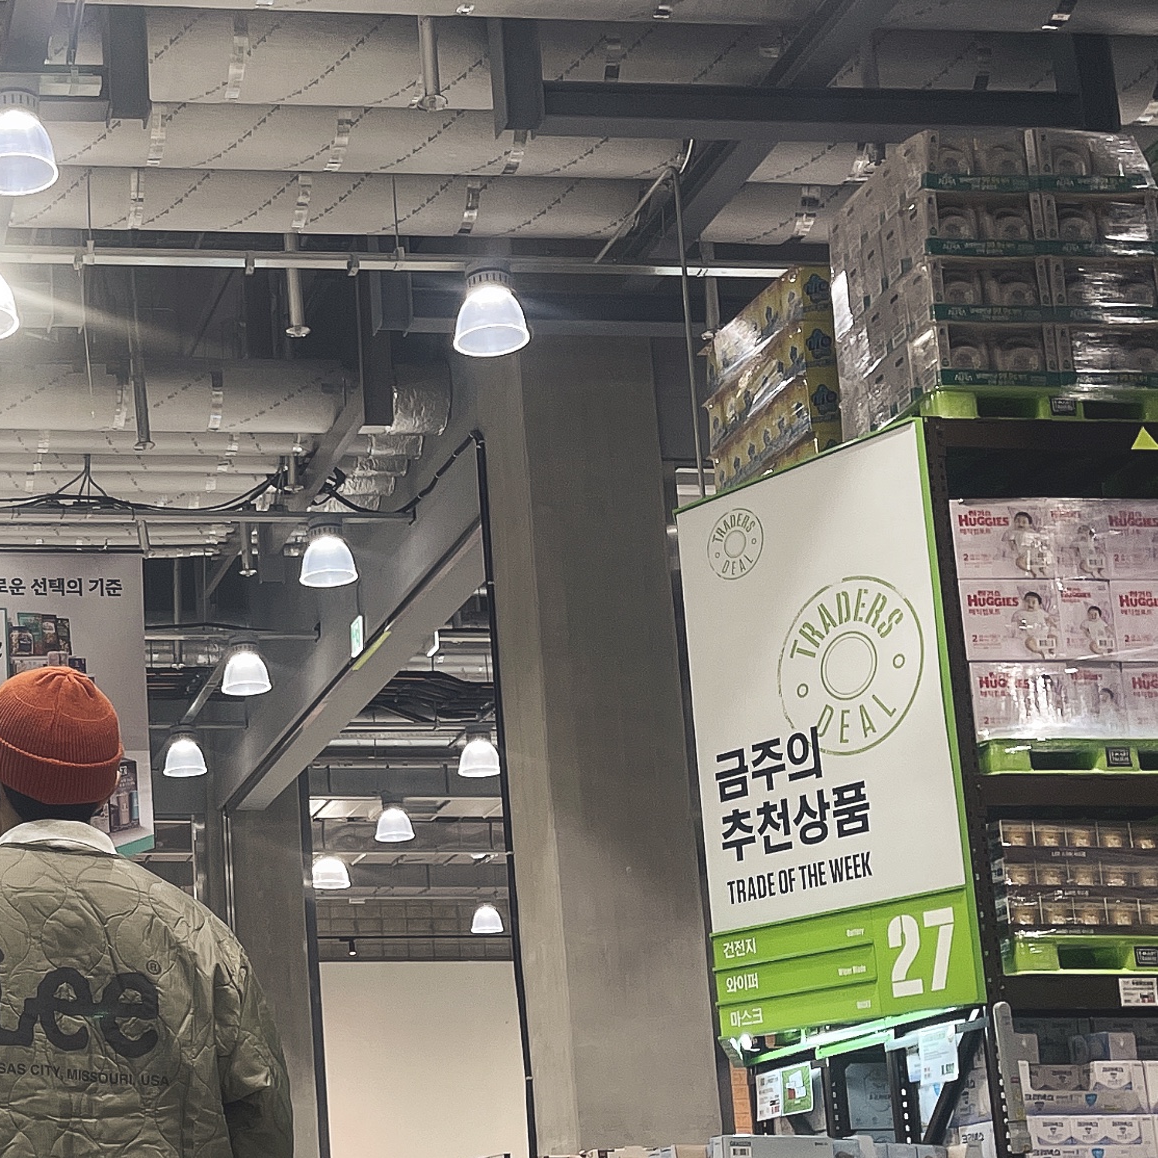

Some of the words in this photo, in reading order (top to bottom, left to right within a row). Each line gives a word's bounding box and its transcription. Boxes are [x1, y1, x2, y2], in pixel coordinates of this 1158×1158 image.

[712, 513, 756, 544] TRADERS
[958, 514, 1009, 527] HUGGIES
[722, 554, 753, 576] DEAL
[31, 577, 83, 597] 선택의
[88, 578, 123, 597] 기준
[967, 594, 1019, 607] HUGGIES
[790, 588, 904, 658] TRADERS
[817, 694, 896, 743] DEAL
[715, 726, 823, 802] 금주의
[721, 780, 870, 862] 추천상품
[727, 874, 776, 904] TRADE
[778, 867, 796, 894] OF
[798, 861, 827, 890] THE
[829, 851, 872, 885] WEEK
[724, 938, 756, 959] 건전지
[887, 906, 954, 998] 27
[726, 973, 758, 992] 와이퍼
[730, 1008, 763, 1027] 마스크
[31, 1064, 62, 1080] CITY,
[67, 1069, 135, 1085] MISSOURI,
[142, 1075, 169, 1086] USA
